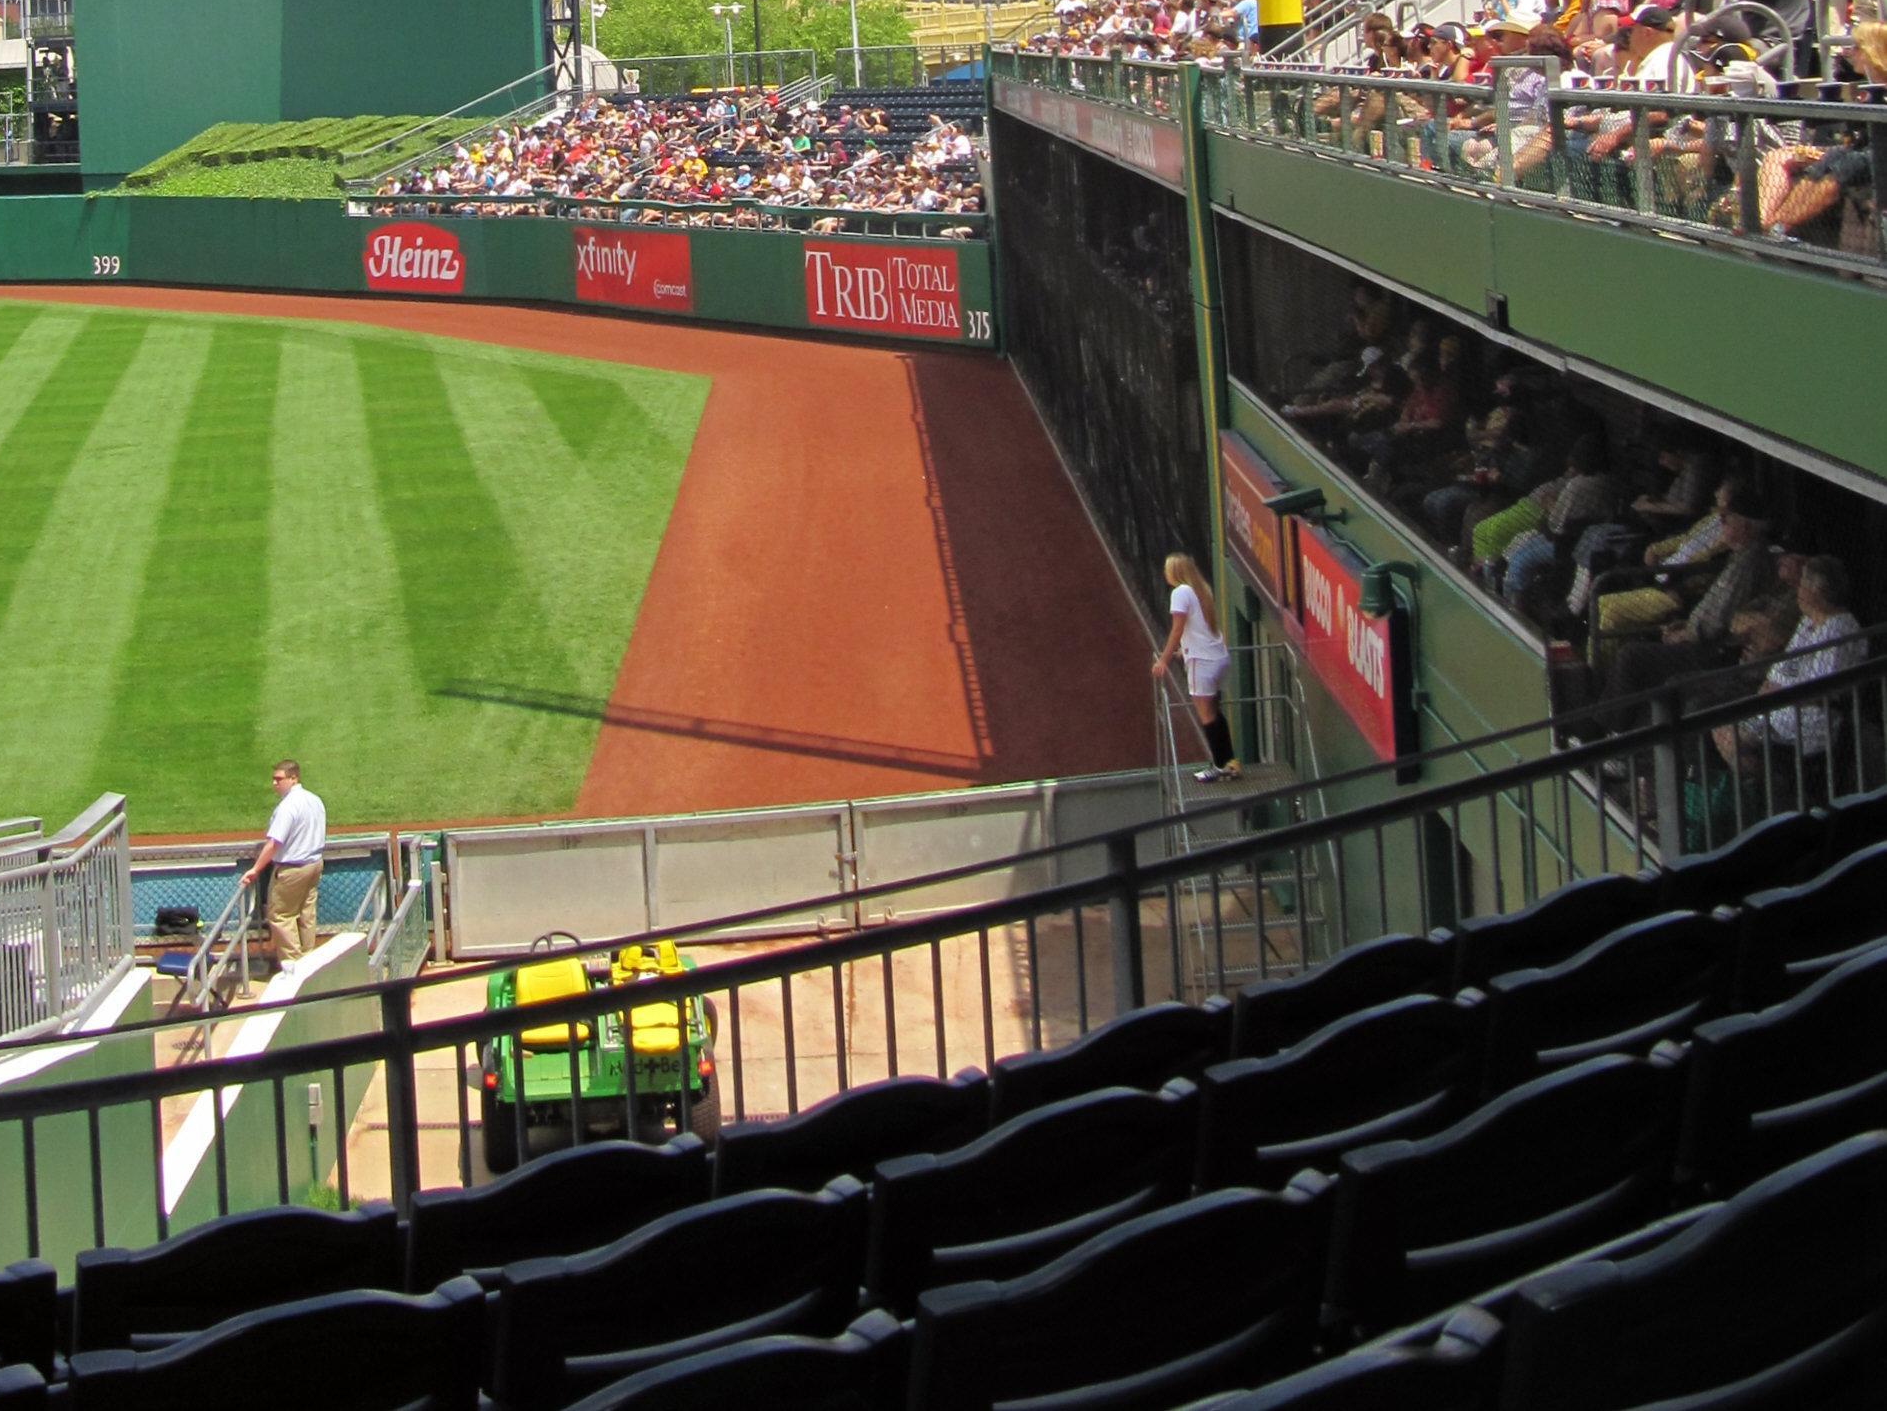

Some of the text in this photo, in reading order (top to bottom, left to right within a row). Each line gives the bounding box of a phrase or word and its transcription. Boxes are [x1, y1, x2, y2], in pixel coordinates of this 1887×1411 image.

[92, 255, 120, 274] 399
[368, 235, 459, 280] Heinz
[577, 236, 636, 285] xfinity
[892, 257, 955, 293] TOTAL
[805, 250, 889, 322] TRIB
[899, 292, 960, 328] MEDIA
[967, 309, 989, 339] 375
[1347, 604, 1385, 700] BLASTS
